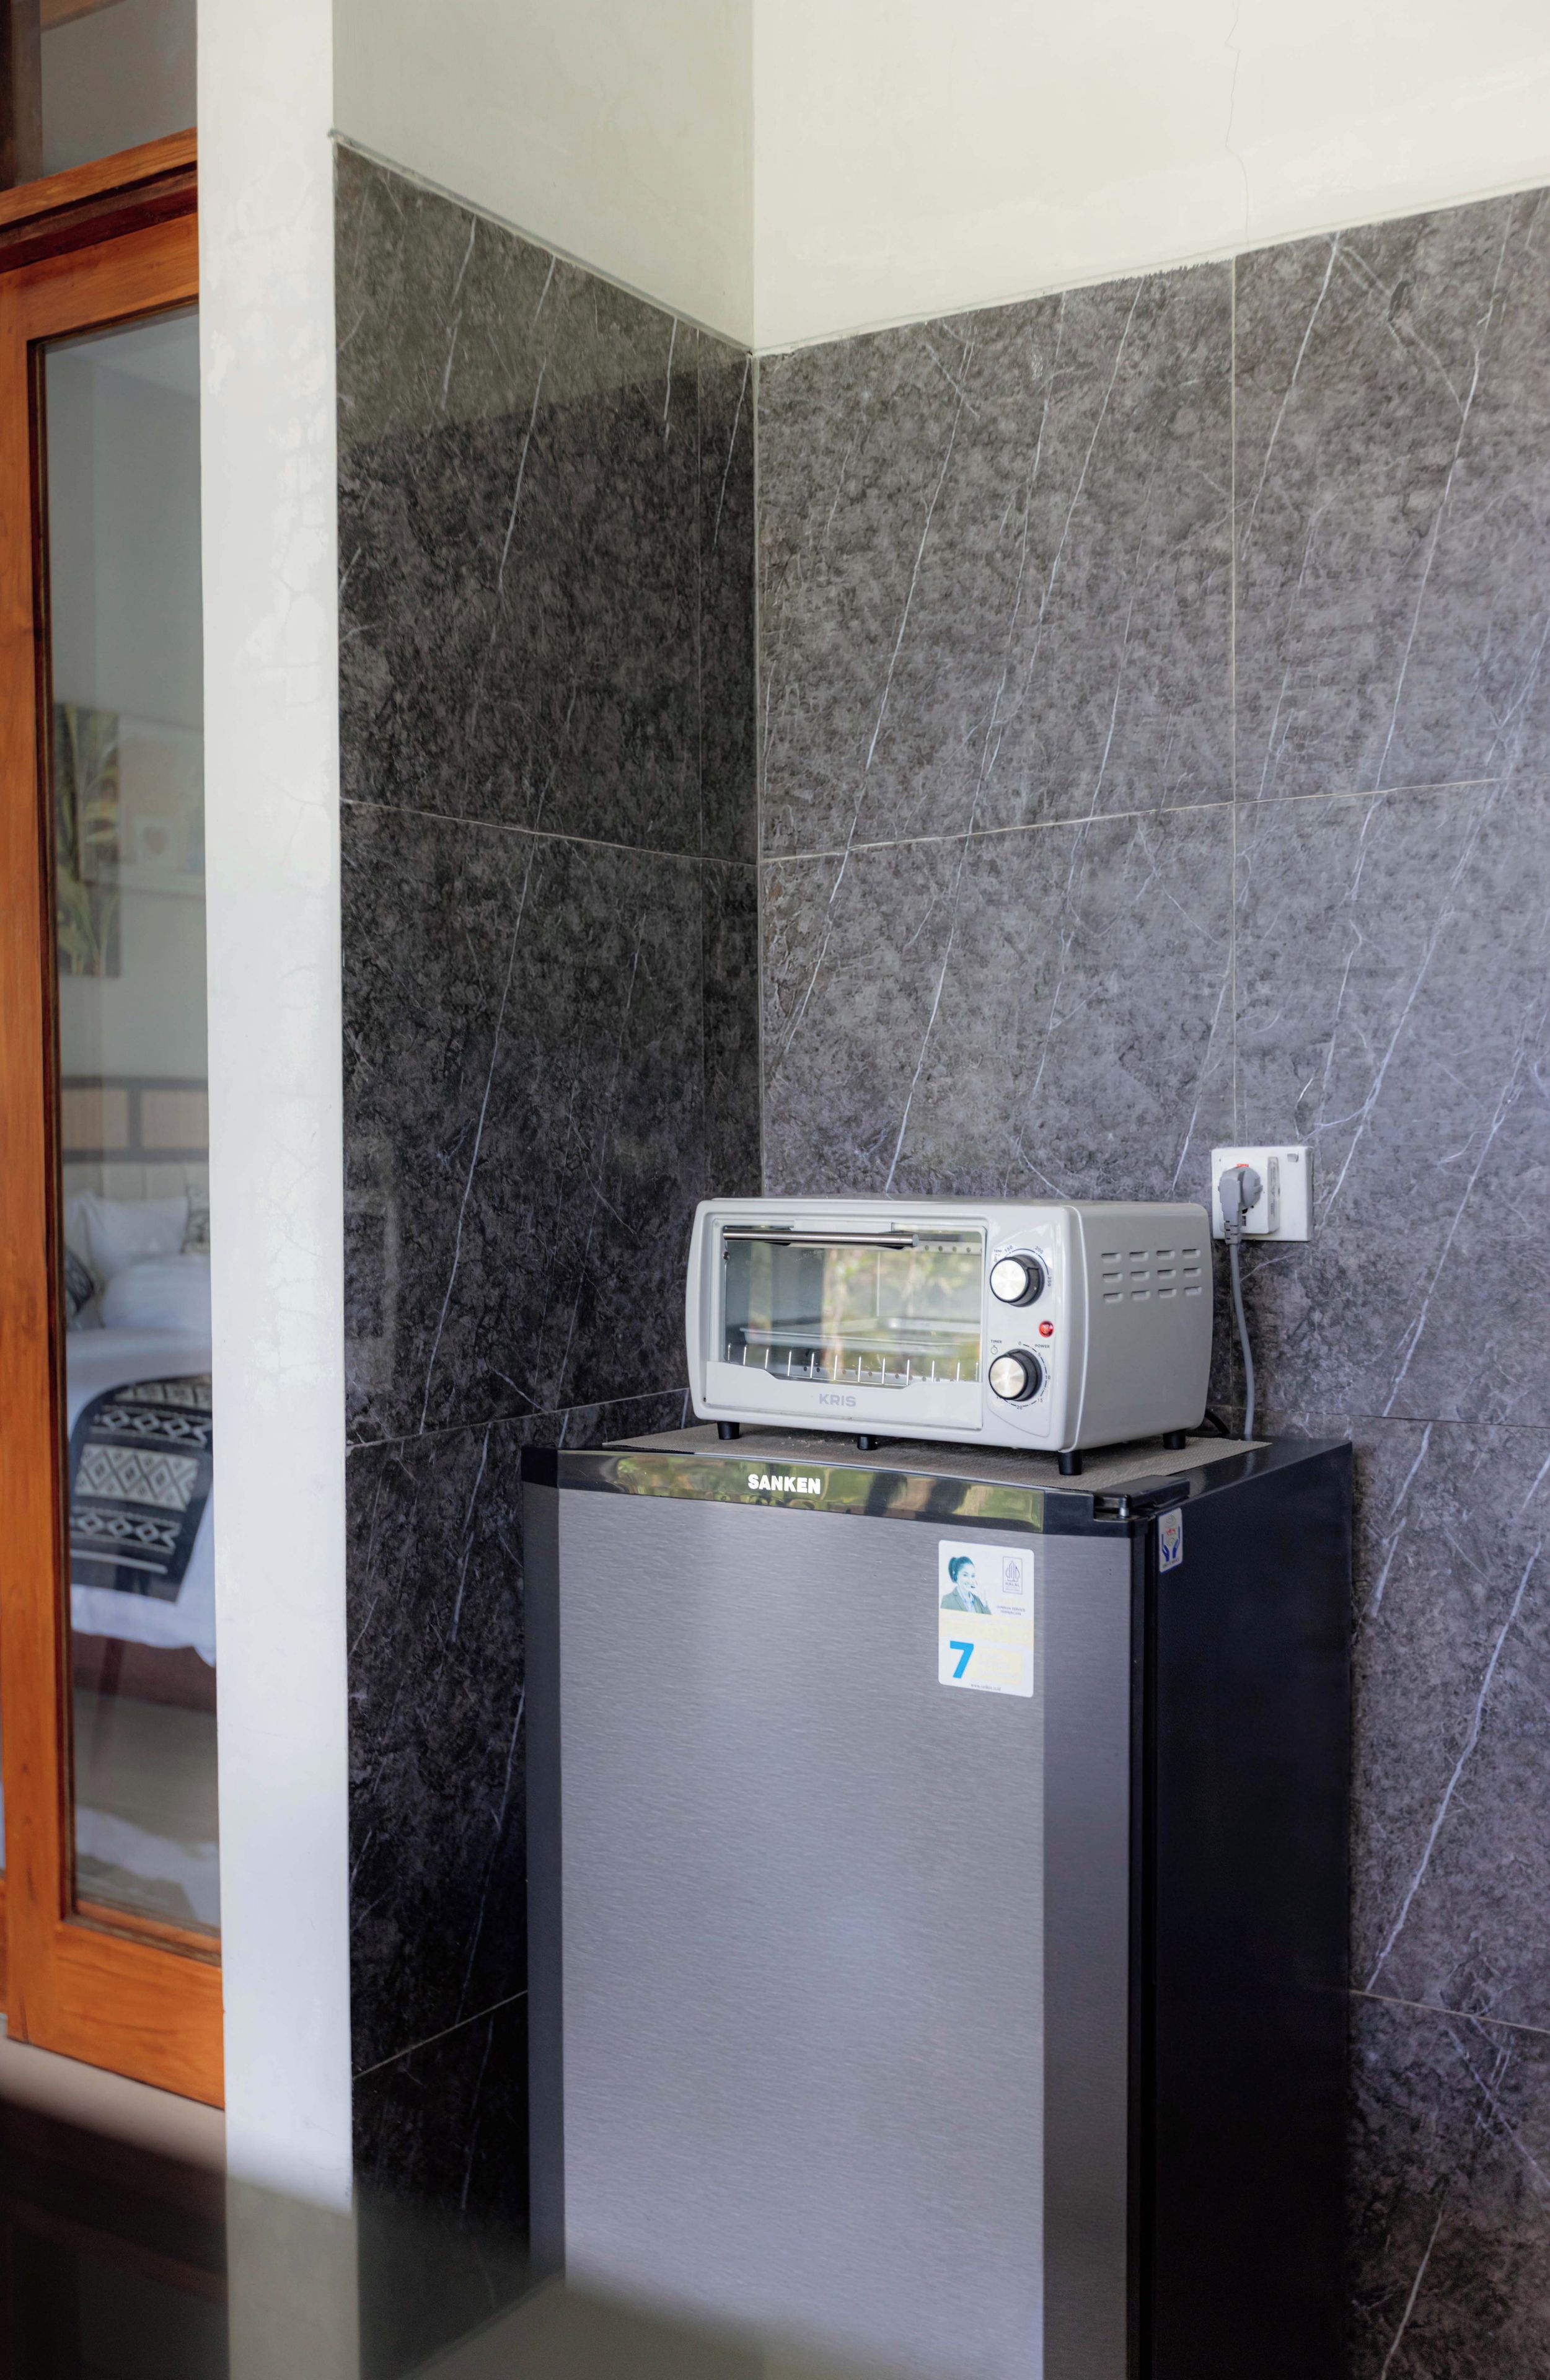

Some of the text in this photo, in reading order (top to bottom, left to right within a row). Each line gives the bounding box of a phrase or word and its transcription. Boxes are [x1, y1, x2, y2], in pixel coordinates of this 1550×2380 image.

[819, 1393, 856, 1407] KRIS
[747, 1473, 821, 1495] SANKEN
[949, 1640, 974, 1679] 7
